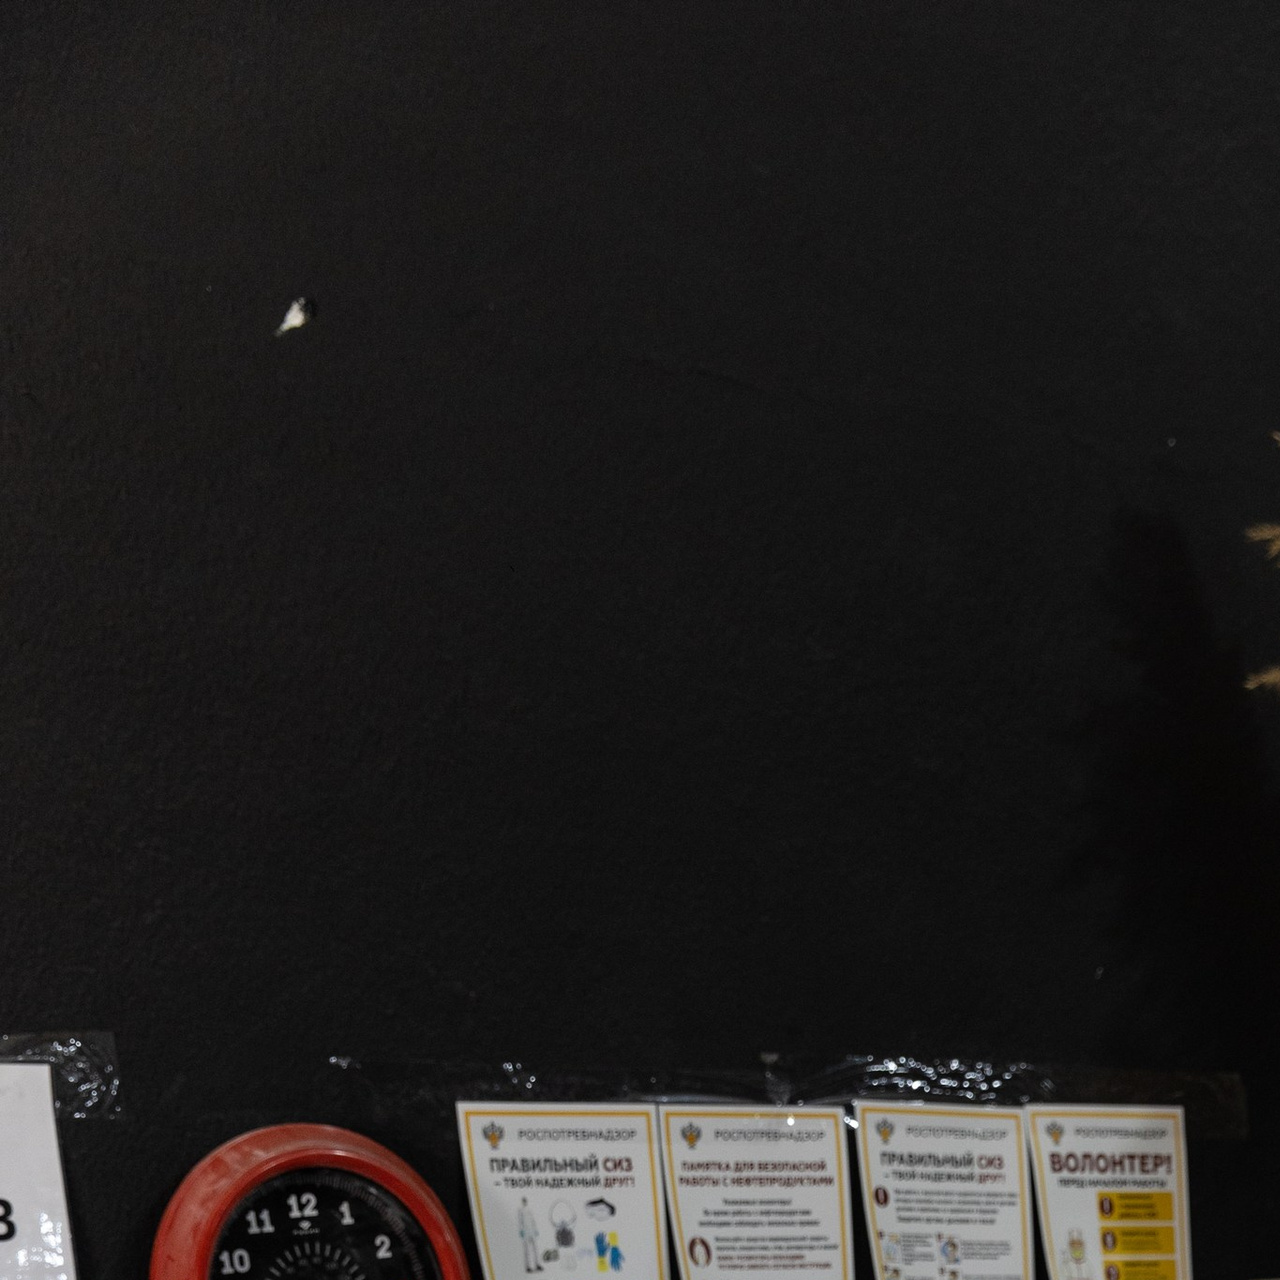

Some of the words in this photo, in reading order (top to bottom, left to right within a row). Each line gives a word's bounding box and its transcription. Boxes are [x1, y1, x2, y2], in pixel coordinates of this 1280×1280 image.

[518, 1128, 637, 1142] РОСПОТРЕБНАДЗОР
[489, 1154, 599, 1173] ПРАВИЛЬНЫЙ
[603, 1157, 633, 1172] СИЗ
[880, 1151, 974, 1168] ПРАВИЛЬНЫЙ
[1050, 1152, 1172, 1176] ВОЛОНТЕР!
[503, 1175, 532, 1190] ТВОЙ
[287, 1192, 319, 1219] 12
[339, 1201, 355, 1225] 1
[246, 1209, 275, 1234] 11
[374, 1234, 392, 1259] 2
[219, 1248, 251, 1275] 10
